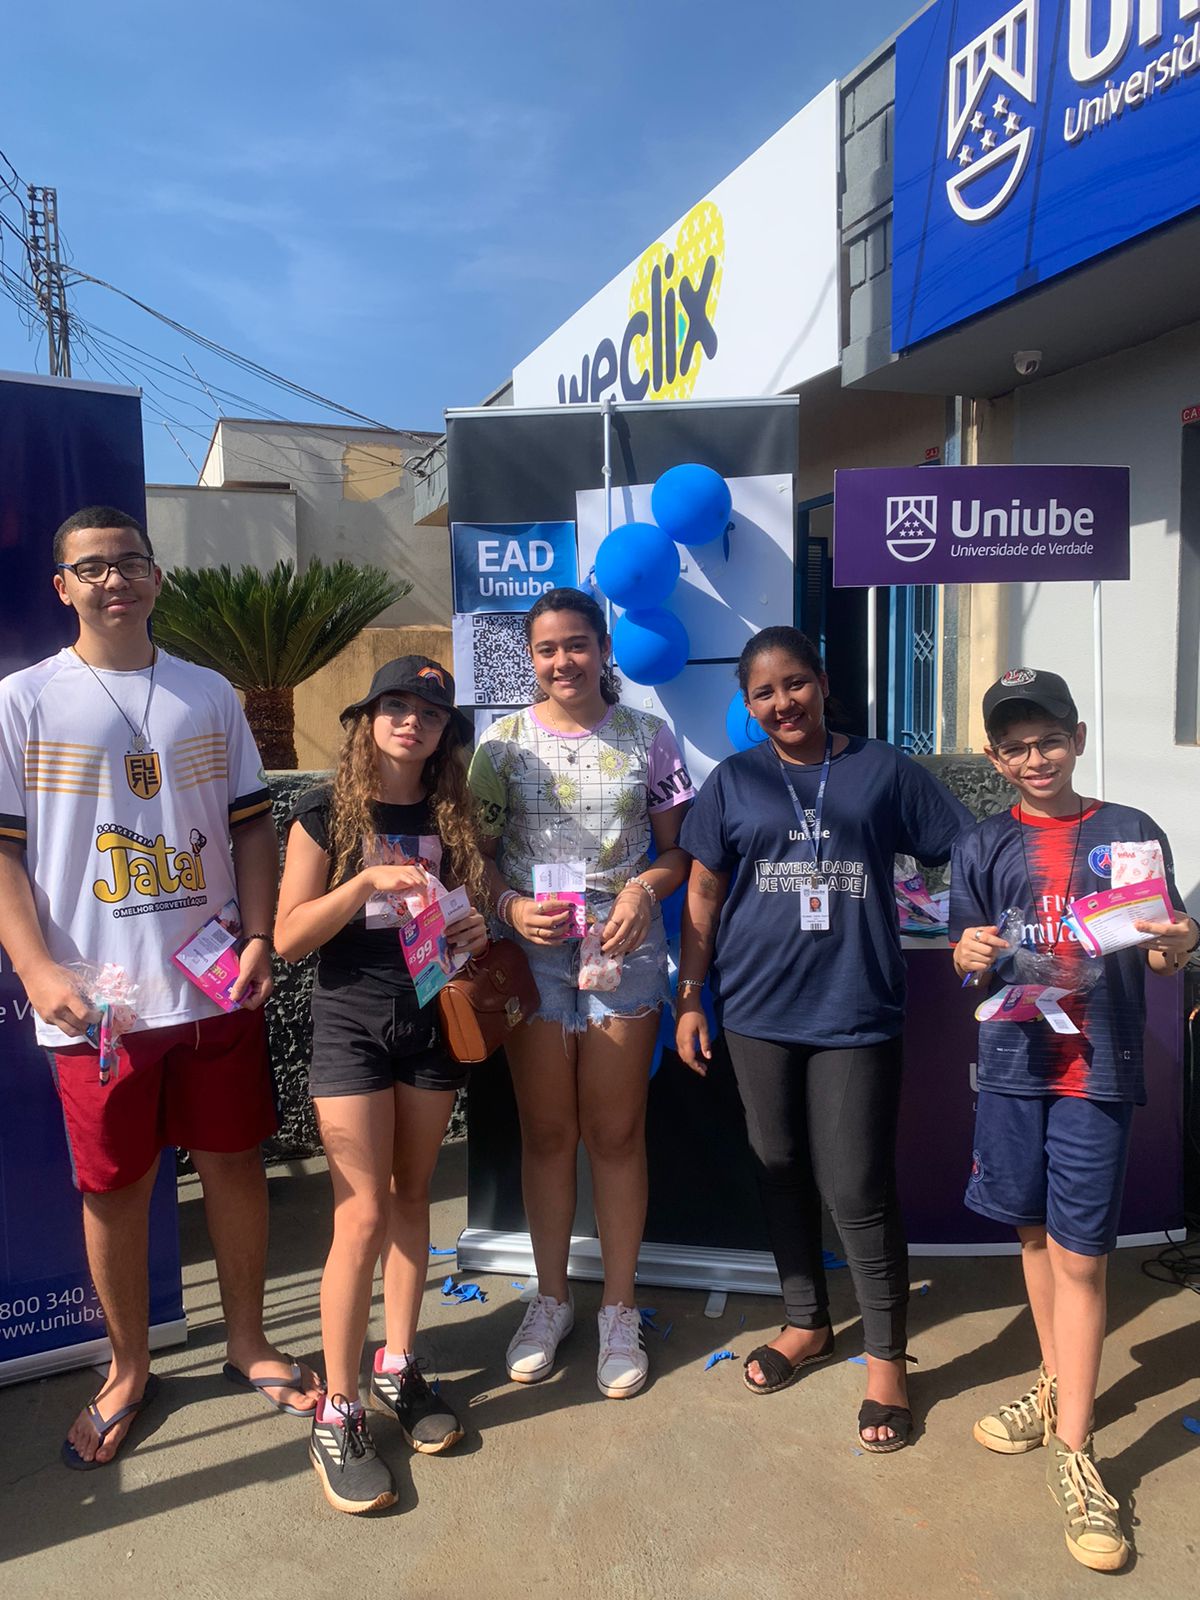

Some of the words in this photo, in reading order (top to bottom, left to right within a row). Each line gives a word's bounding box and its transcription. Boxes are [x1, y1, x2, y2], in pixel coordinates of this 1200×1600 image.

[558, 253, 718, 404] weclix
[951, 498, 1095, 538] Uniube
[478, 540, 555, 572] EAD
[950, 543, 1029, 557] Universidade
[1031, 542, 1047, 555] de
[1049, 541, 1094, 555] Verdade
[480, 576, 555, 597] Uniube
[97, 823, 154, 847] SORVETERIA
[759, 877, 778, 892] DE
[113, 909, 121, 918] O
[121, 903, 155, 917] MELHOR
[154, 898, 187, 911] SORVETE
[409, 954, 417, 965] R$
[416, 939, 433, 964] 99
[46, 1287, 84, 1310] 340
